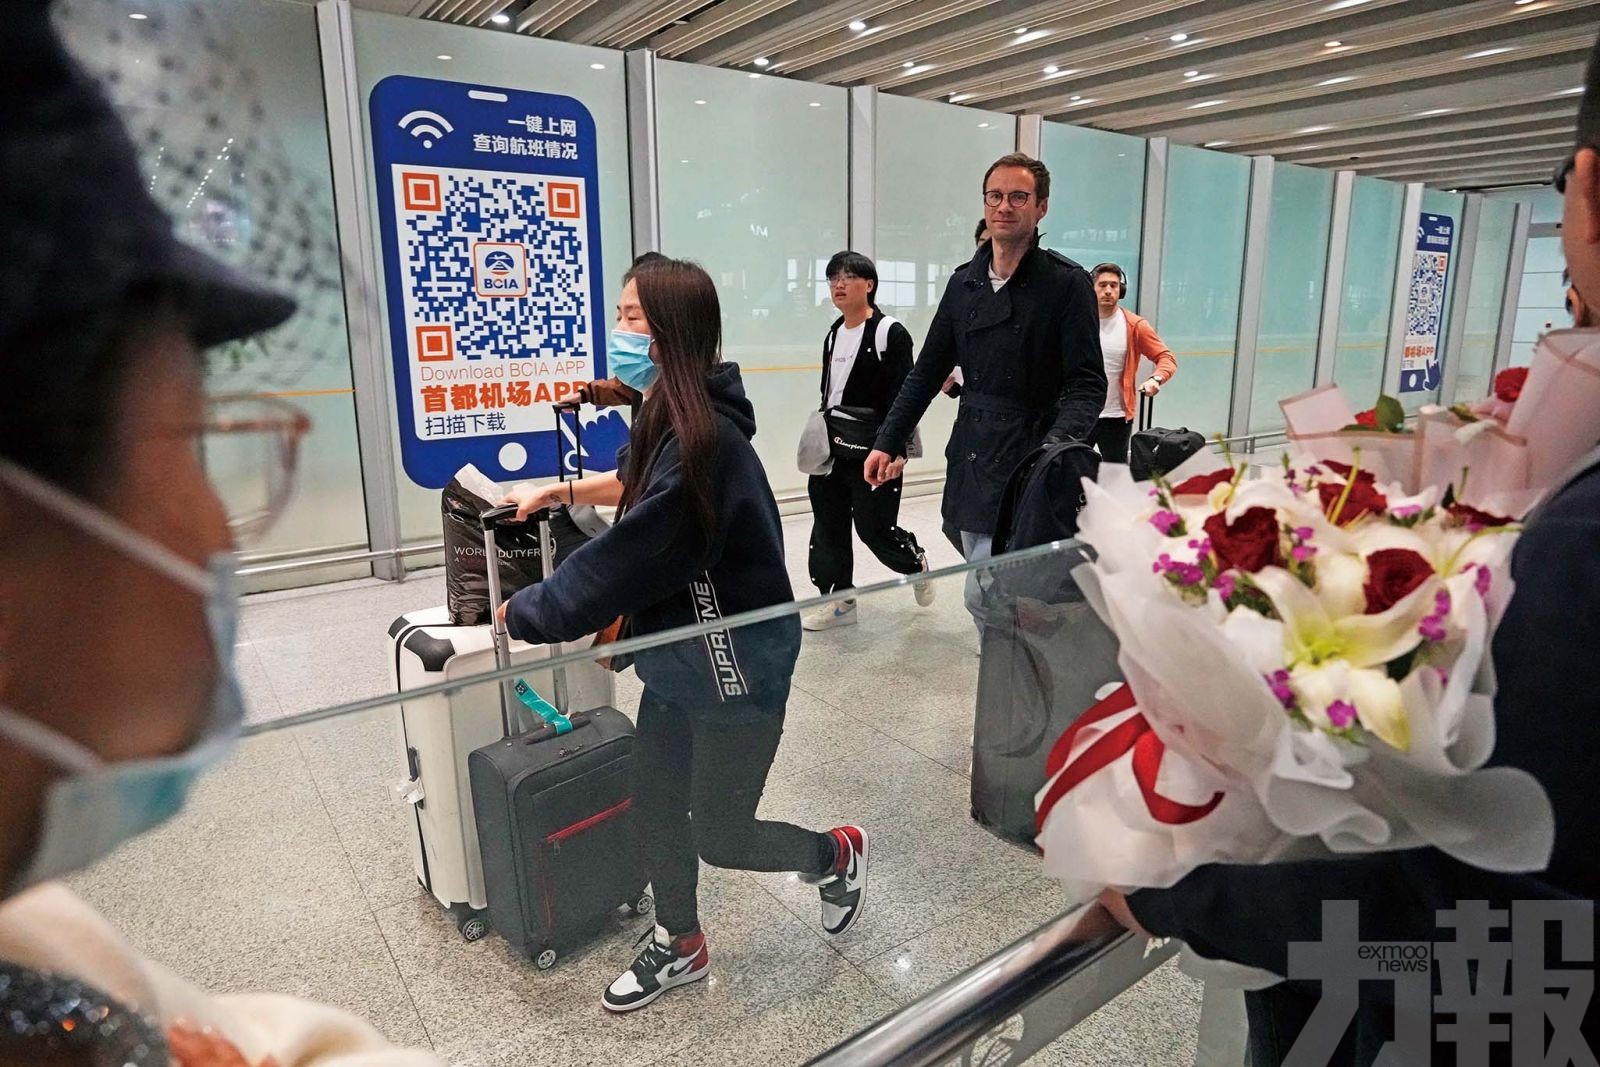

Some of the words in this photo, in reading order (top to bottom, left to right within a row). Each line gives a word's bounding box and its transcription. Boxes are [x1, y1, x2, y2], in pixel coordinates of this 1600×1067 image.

[507, 114, 577, 138] 一键上网
[473, 133, 579, 160] 查询航班情况
[484, 278, 519, 289] BCIA
[420, 364, 504, 382] Download
[509, 361, 550, 378] BCIA
[554, 360, 586, 376] APP
[425, 411, 507, 437] 扫描下载
[454, 546, 488, 558] WORL
